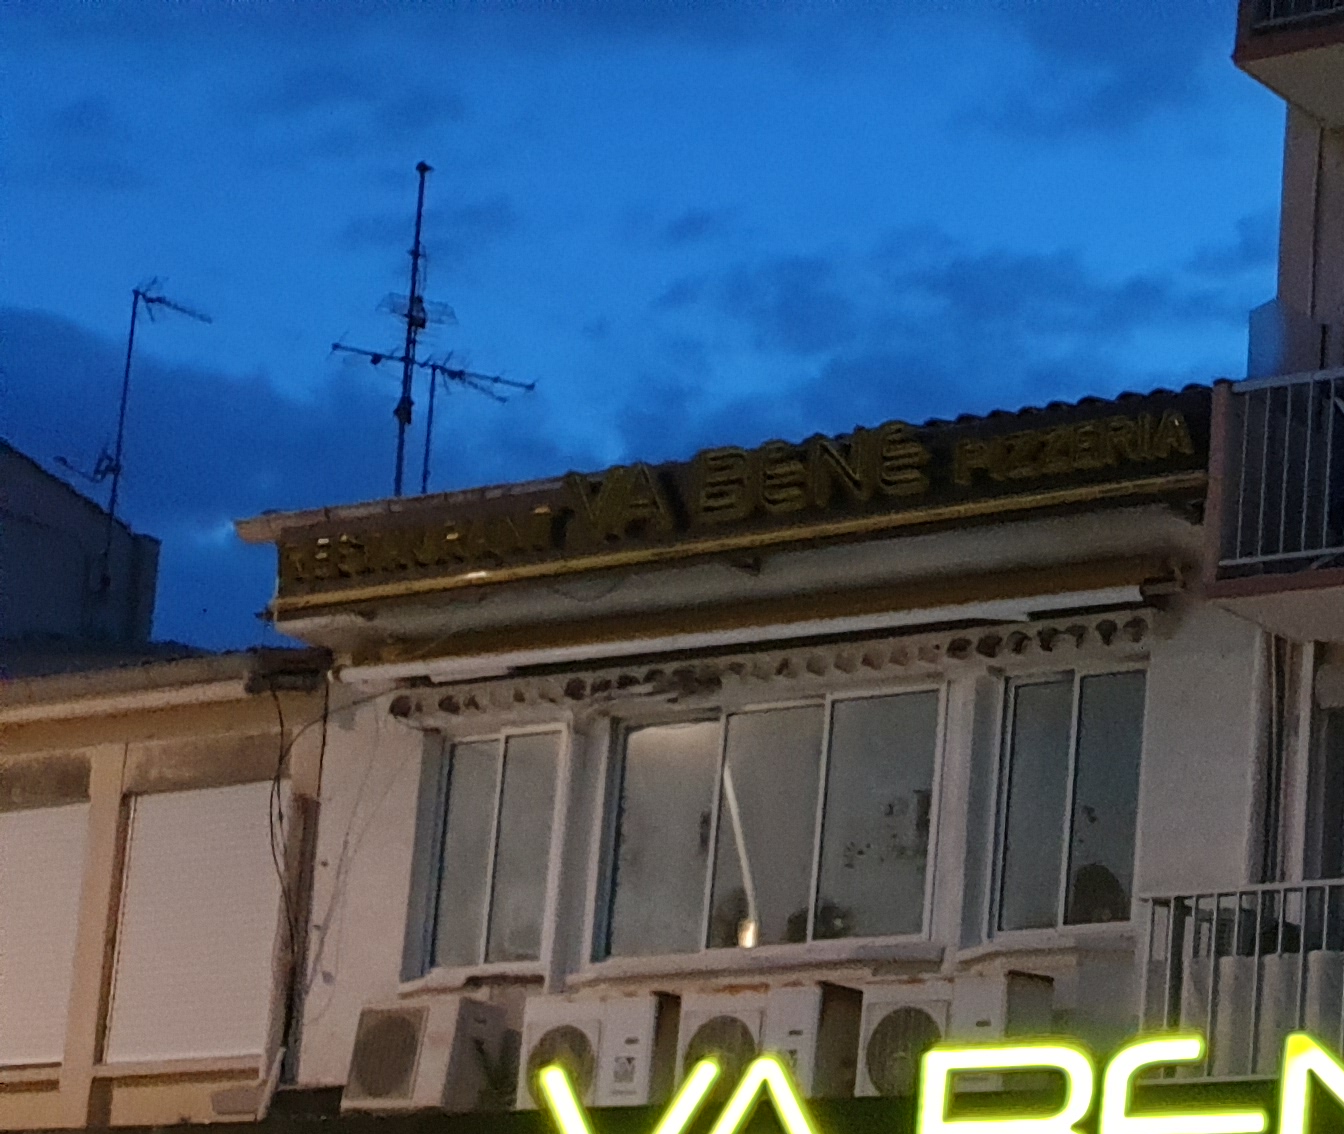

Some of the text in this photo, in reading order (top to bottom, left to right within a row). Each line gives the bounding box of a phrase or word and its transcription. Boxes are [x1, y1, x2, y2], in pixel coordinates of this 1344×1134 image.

[563, 460, 676, 540] VA
[693, 421, 930, 524] BENE
[953, 408, 1196, 486] PIZZERIA
